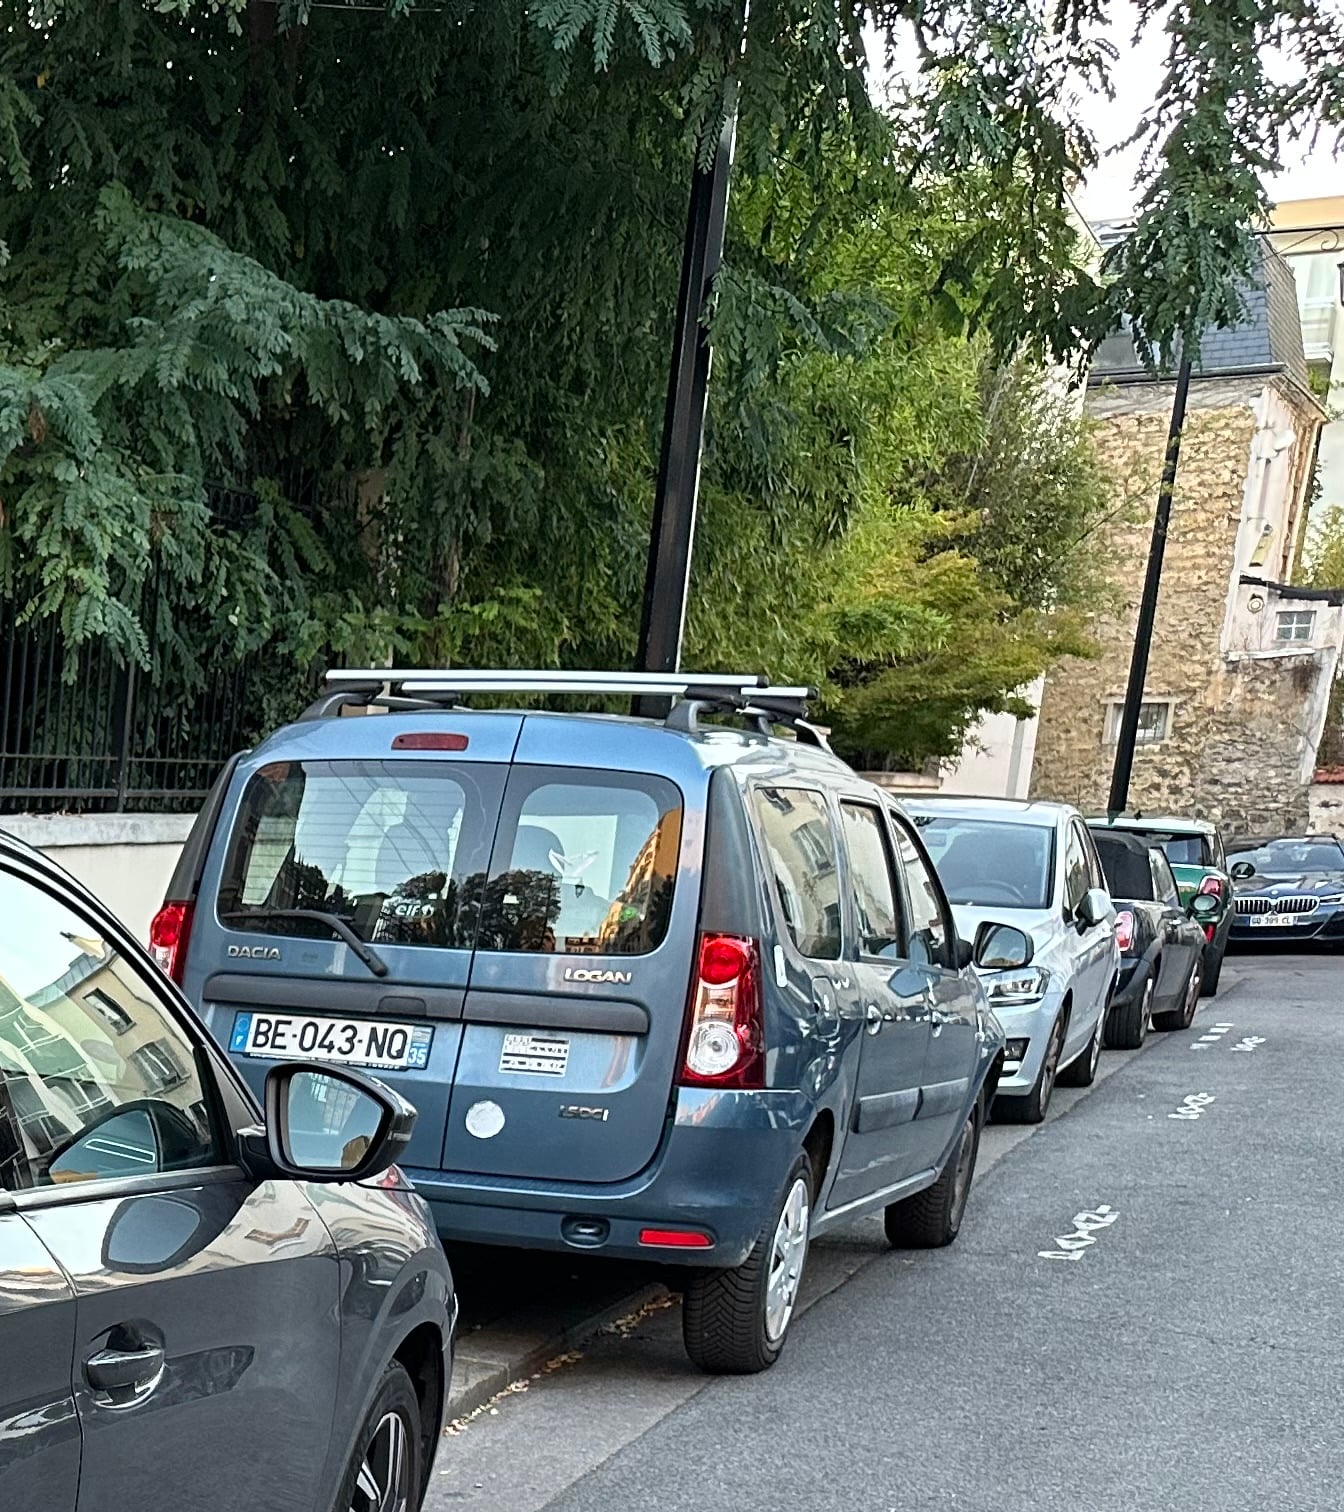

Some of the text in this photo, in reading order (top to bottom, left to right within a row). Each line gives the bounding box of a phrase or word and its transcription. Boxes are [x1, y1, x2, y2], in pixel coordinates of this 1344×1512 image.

[227, 945, 281, 960] DACIA
[564, 967, 632, 984] LOGAN
[251, 1018, 408, 1060] BE-043-NQ
[407, 1047, 427, 1065] 35
